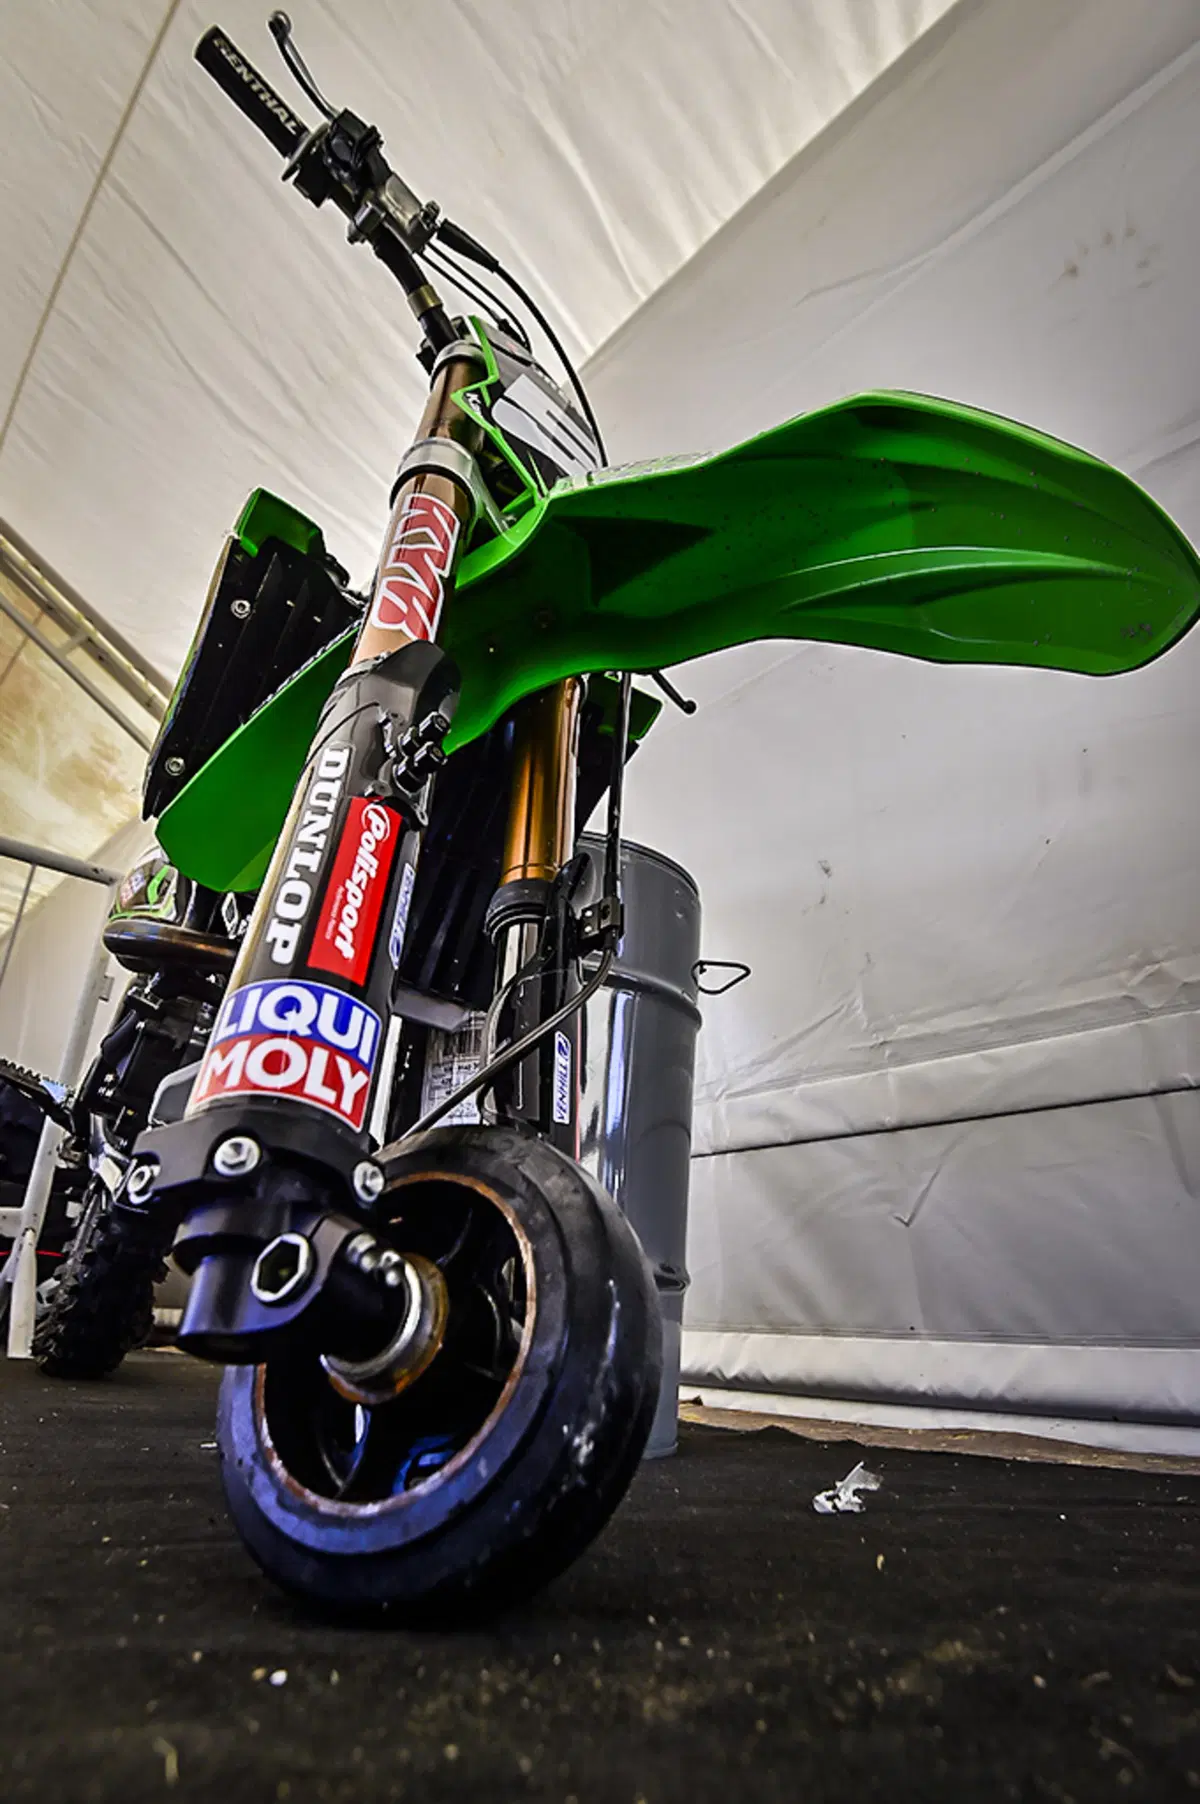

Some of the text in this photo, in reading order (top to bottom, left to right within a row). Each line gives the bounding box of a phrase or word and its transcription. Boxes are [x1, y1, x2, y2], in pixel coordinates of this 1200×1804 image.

[213, 38, 297, 135] RENTHAL
[372, 493, 460, 643] KYB
[265, 747, 350, 965] DUNLOP
[334, 803, 391, 960] Polisport
[199, 1037, 369, 1115] MOLY
[216, 985, 376, 1064] LIQUI
